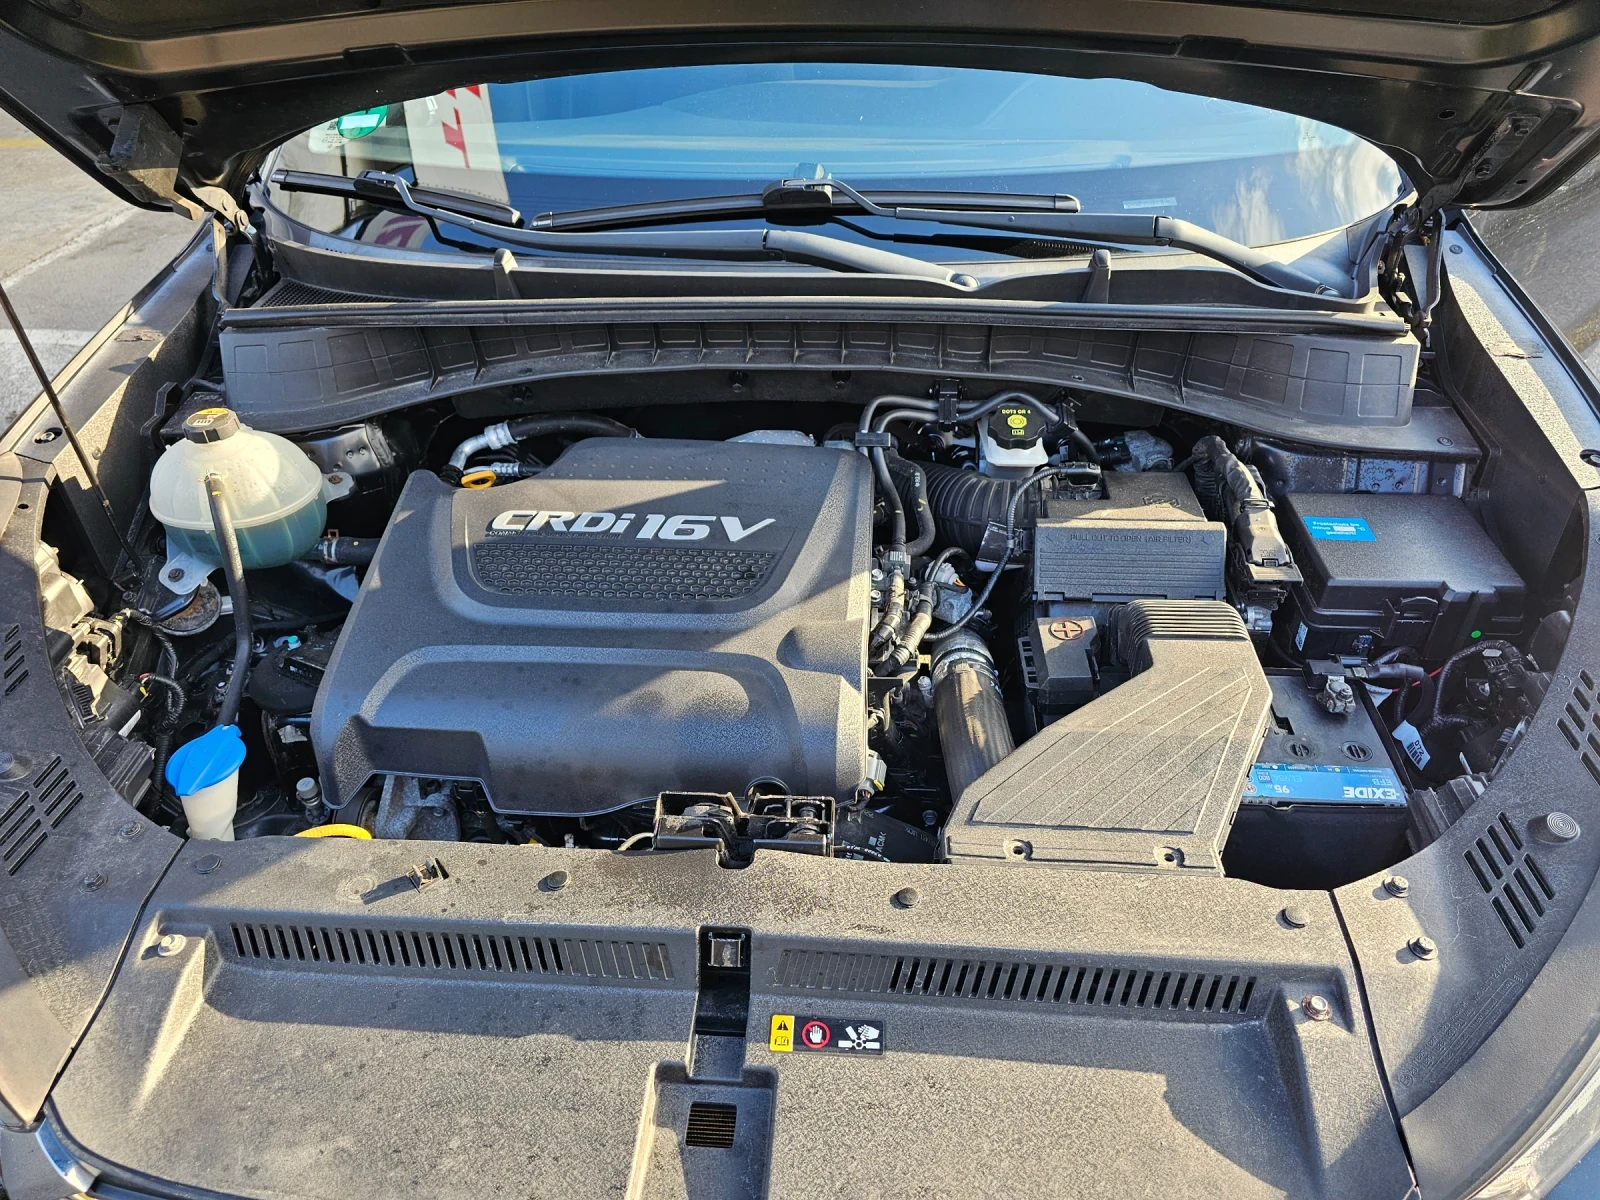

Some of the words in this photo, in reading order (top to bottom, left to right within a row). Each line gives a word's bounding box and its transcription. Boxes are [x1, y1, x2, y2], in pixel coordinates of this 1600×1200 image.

[491, 509, 636, 533] CRDi
[635, 513, 776, 542] 16V
[1108, 534, 1119, 542] TO
[1274, 784, 1290, 794] 95
[1343, 786, 1400, 800] EXIDE
